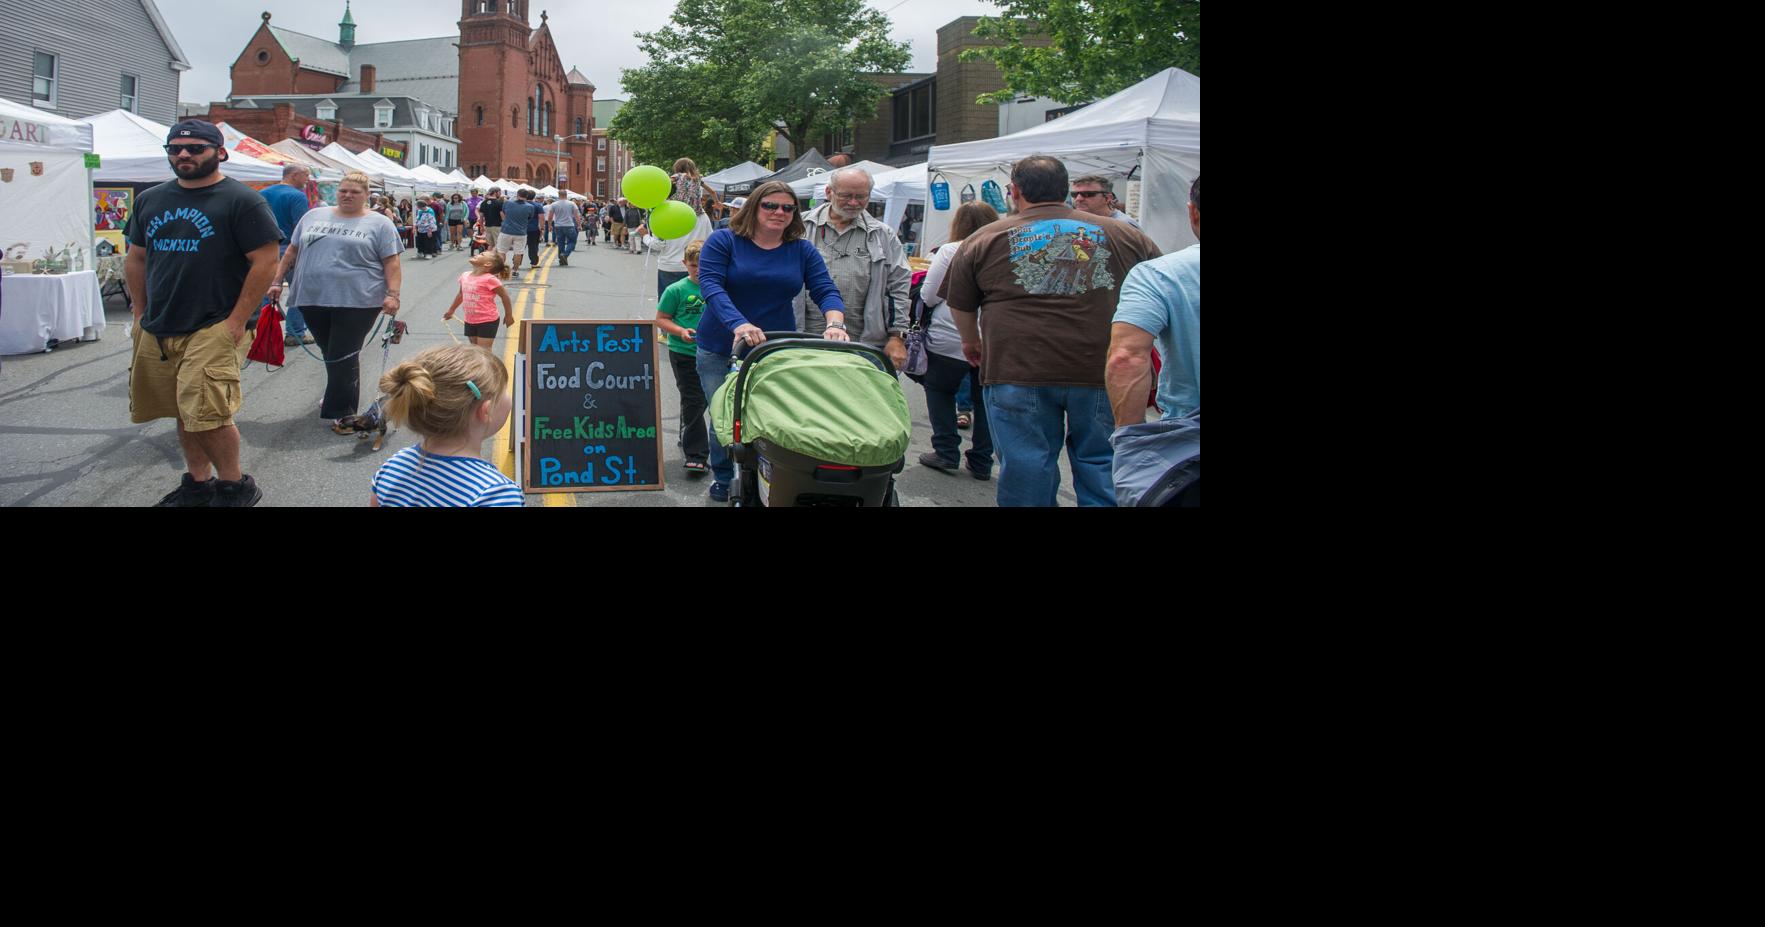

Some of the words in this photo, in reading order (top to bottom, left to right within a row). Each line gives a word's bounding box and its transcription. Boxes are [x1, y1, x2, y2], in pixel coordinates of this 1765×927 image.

[146, 207, 215, 238] CHAMPION
[307, 226, 368, 239] CHEMISTRY
[538, 324, 591, 353] Arts
[595, 324, 644, 353] Fest
[536, 363, 581, 390] Food
[585, 361, 653, 390] Court
[582, 393, 598, 410] &
[533, 416, 572, 440] Free
[573, 416, 615, 439] Kids
[616, 415, 657, 439] Area
[583, 443, 606, 455] on
[539, 457, 595, 486] Pond
[601, 455, 646, 485] St.
